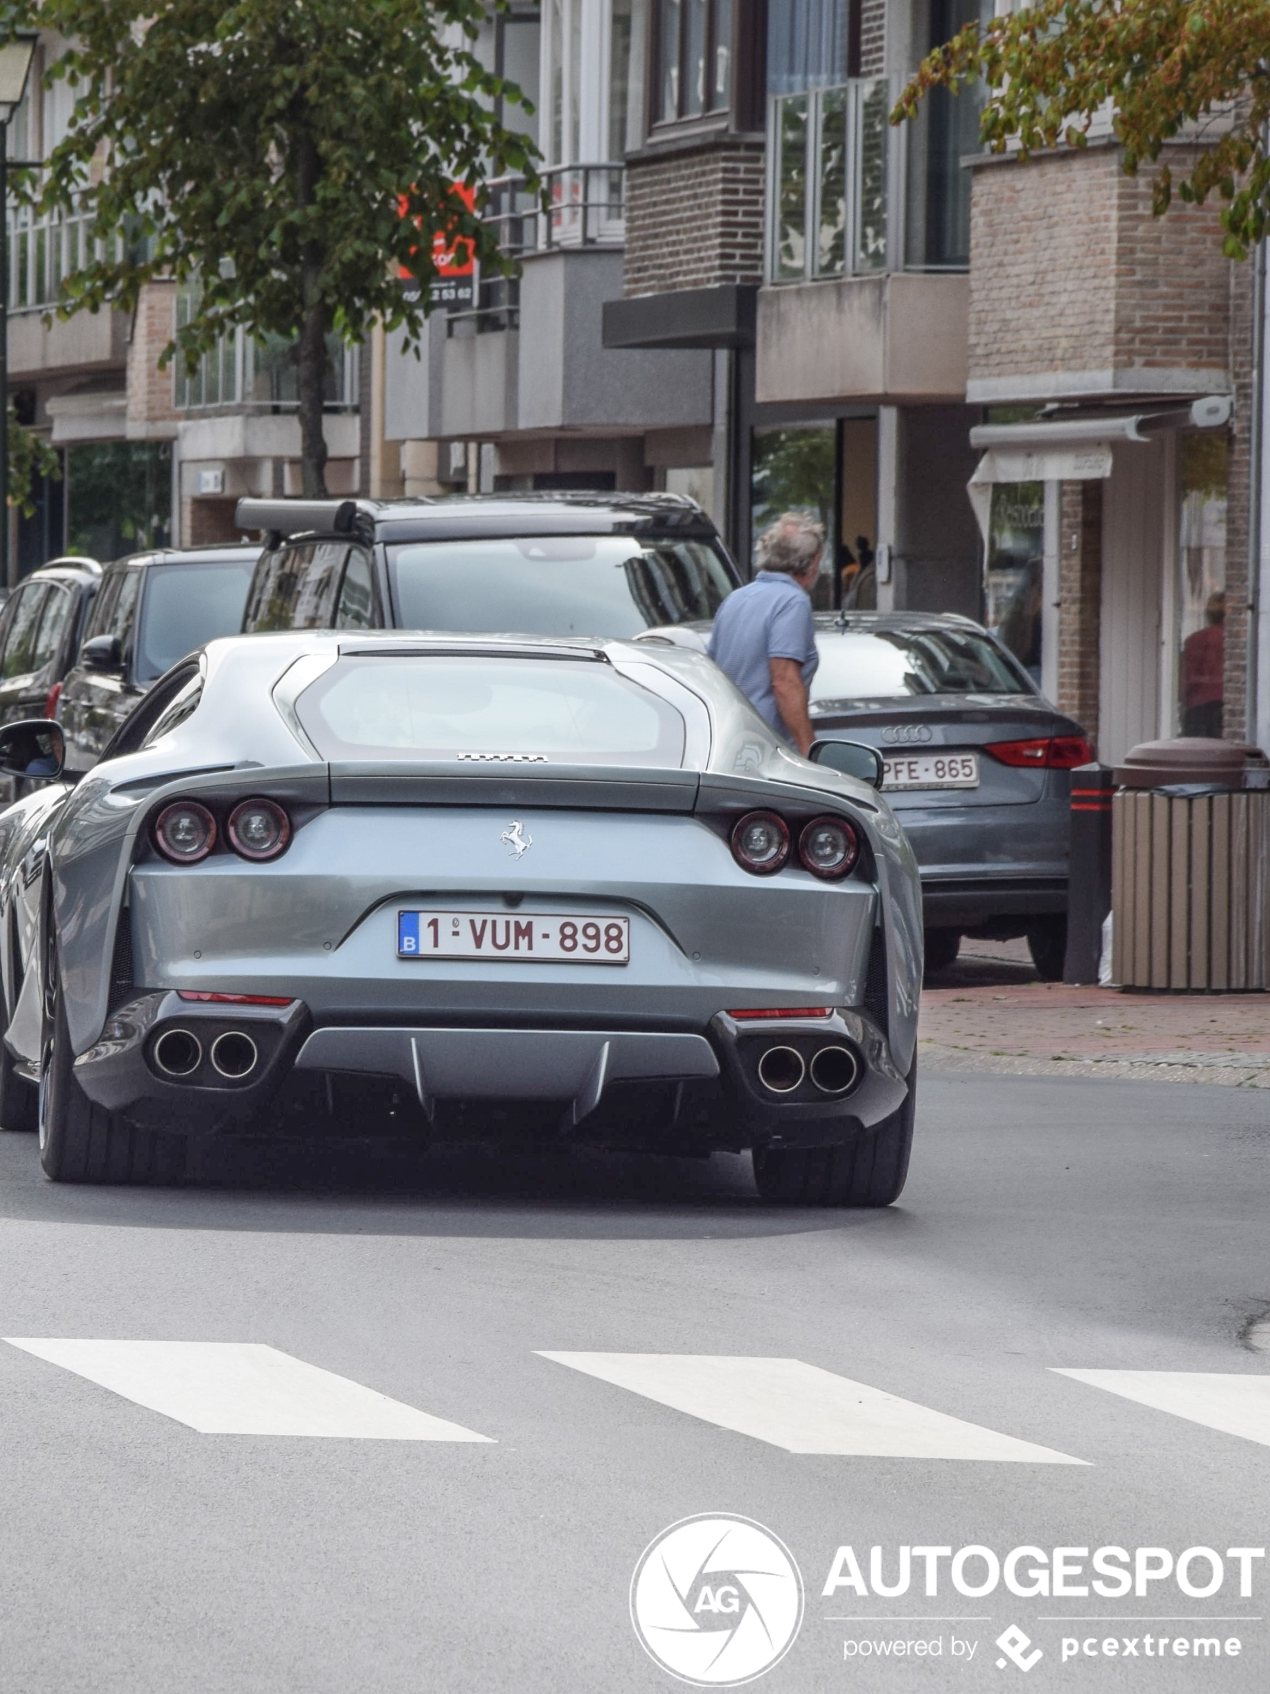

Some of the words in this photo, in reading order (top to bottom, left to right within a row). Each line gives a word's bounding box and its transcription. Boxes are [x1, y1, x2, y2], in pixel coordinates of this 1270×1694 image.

[441, 288, 456, 300] 53
[457, 287, 472, 299] 62
[403, 937, 416, 951] B
